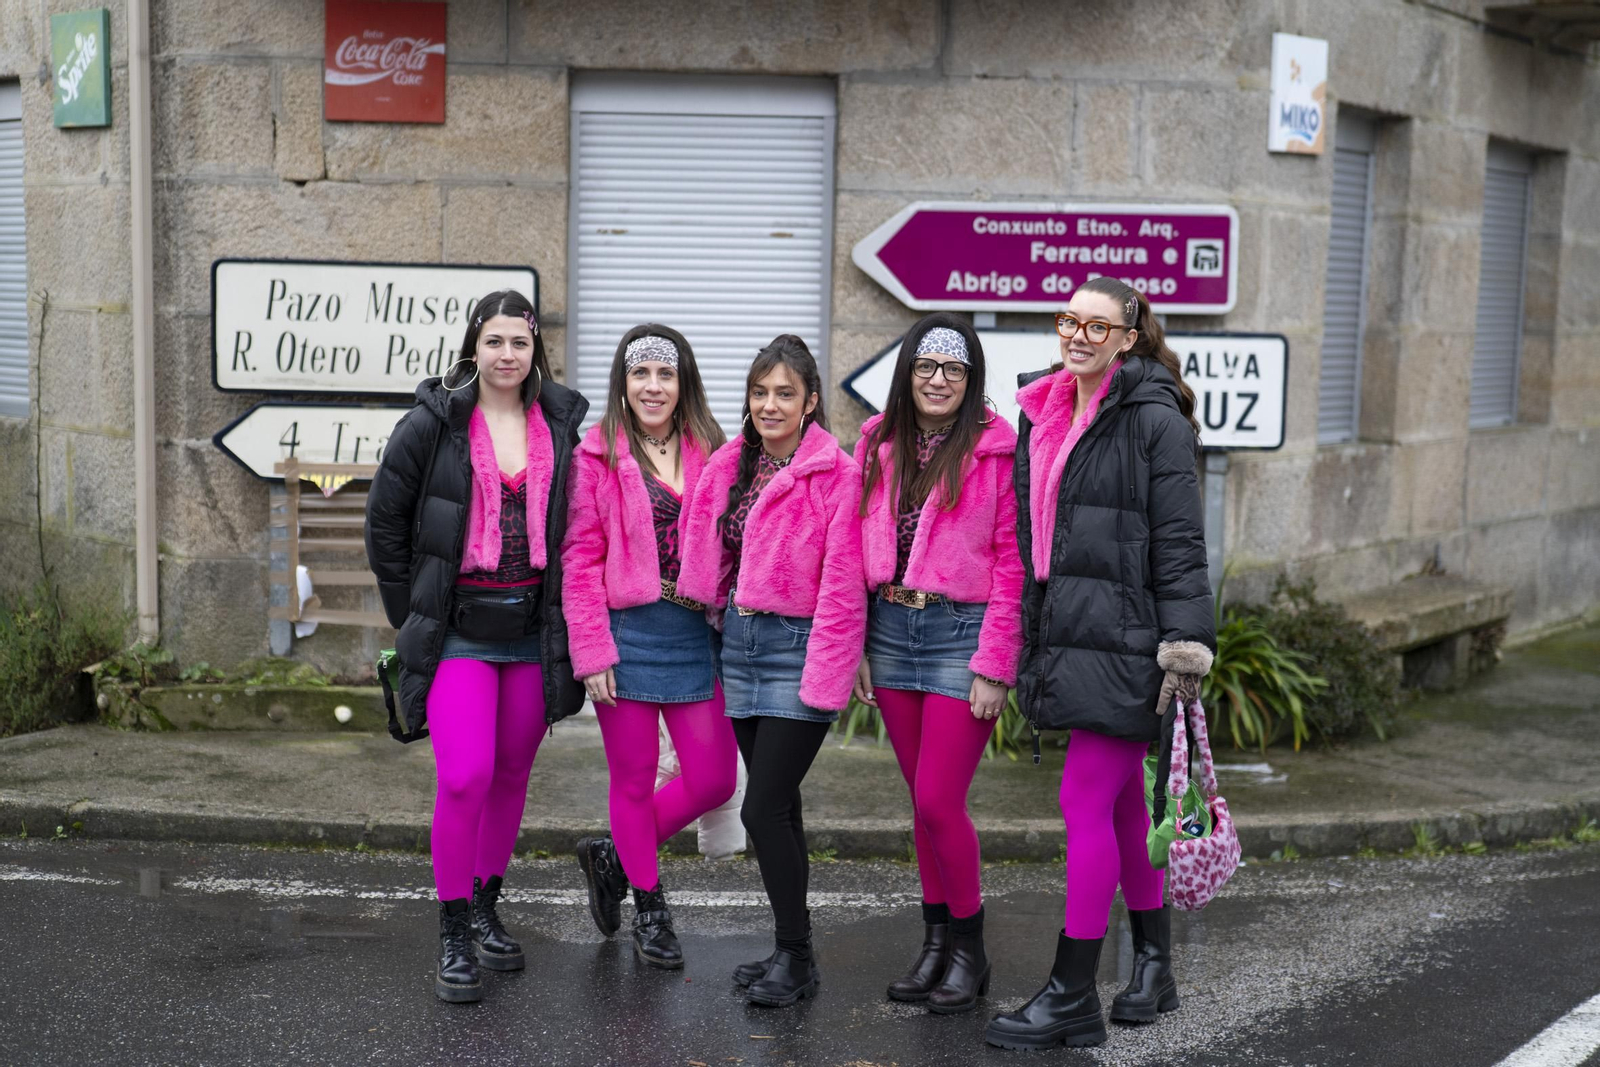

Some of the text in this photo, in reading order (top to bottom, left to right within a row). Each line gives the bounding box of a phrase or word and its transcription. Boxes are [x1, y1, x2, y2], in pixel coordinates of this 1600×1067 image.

[58, 32, 97, 105] Sprite
[392, 70, 423, 86] Coke
[1280, 102, 1319, 132] MIKO
[973, 216, 1179, 241] Conxunto Etno. Arq.
[1030, 241, 1179, 264] Ferradura e
[946, 270, 1028, 297] Abrigo
[1041, 272, 1073, 293] do
[266, 278, 341, 322] Pazo
[231, 330, 257, 372] R.
[275, 331, 361, 375] Otero
[279, 421, 300, 458] 4
